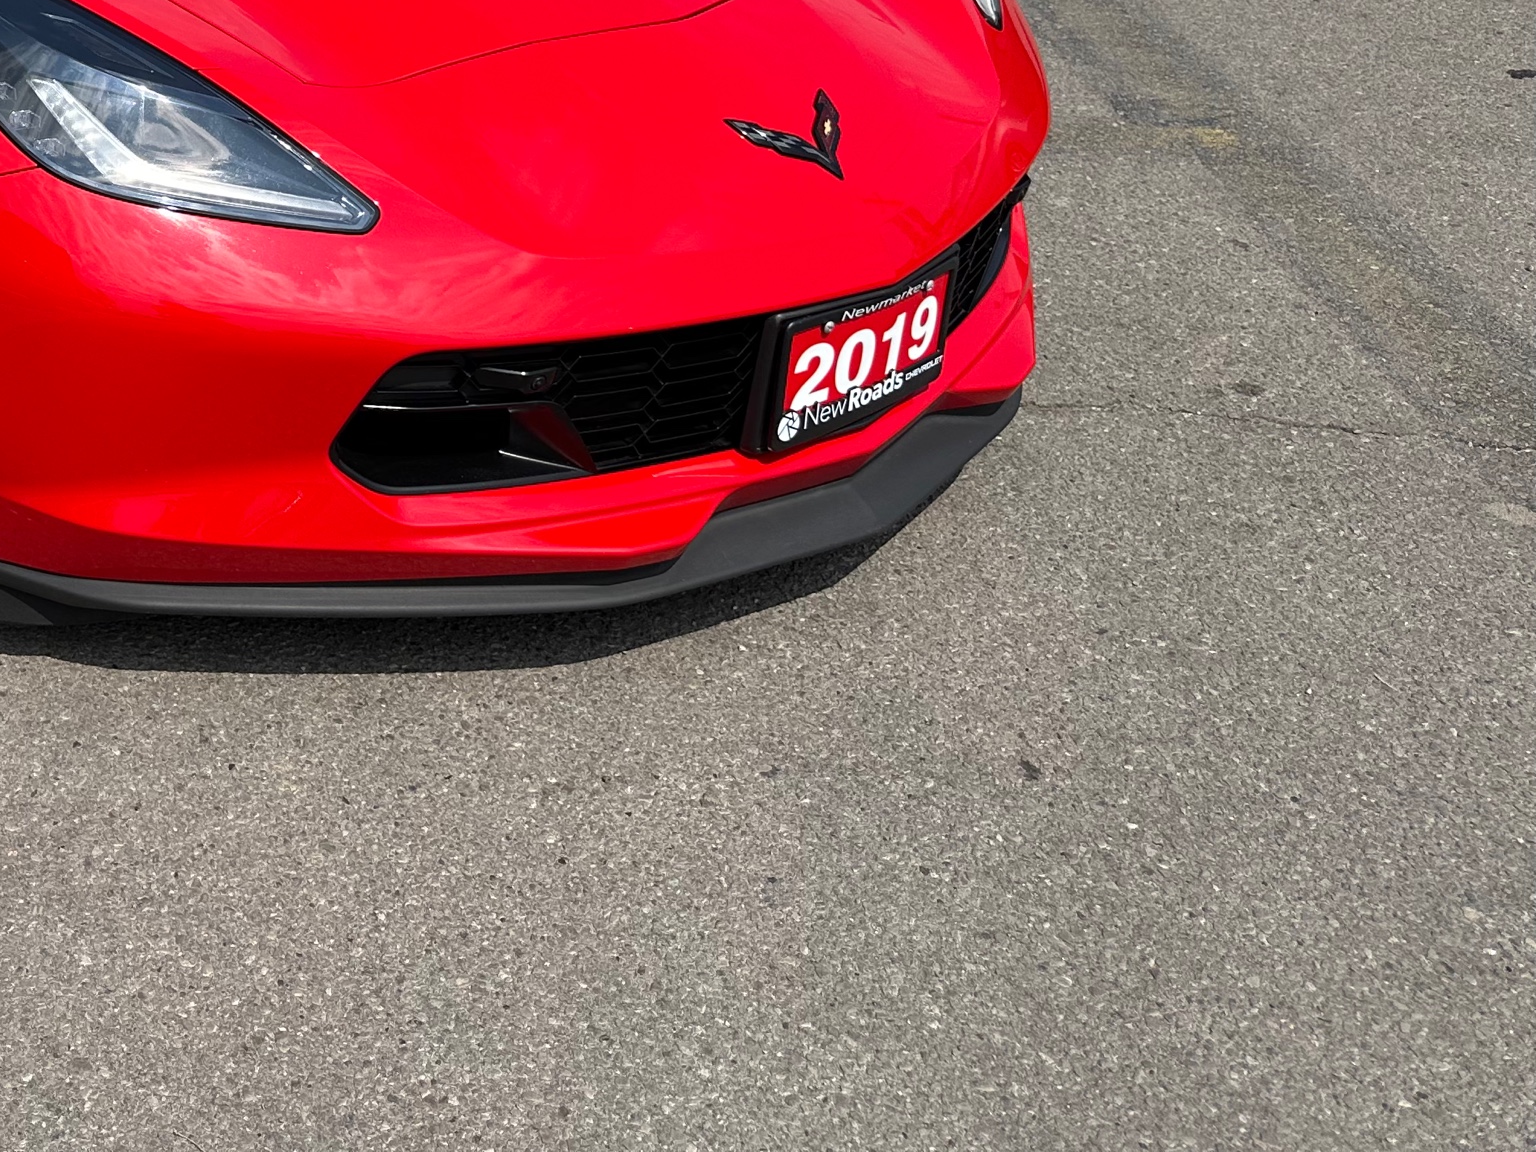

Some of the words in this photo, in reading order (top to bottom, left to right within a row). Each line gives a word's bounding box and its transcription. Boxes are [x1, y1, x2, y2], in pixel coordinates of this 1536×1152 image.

[841, 280, 927, 322] Newmarket
[789, 295, 938, 412] 2019
[803, 369, 904, 430] NewRoads
[905, 354, 943, 381] CHEVROLET
